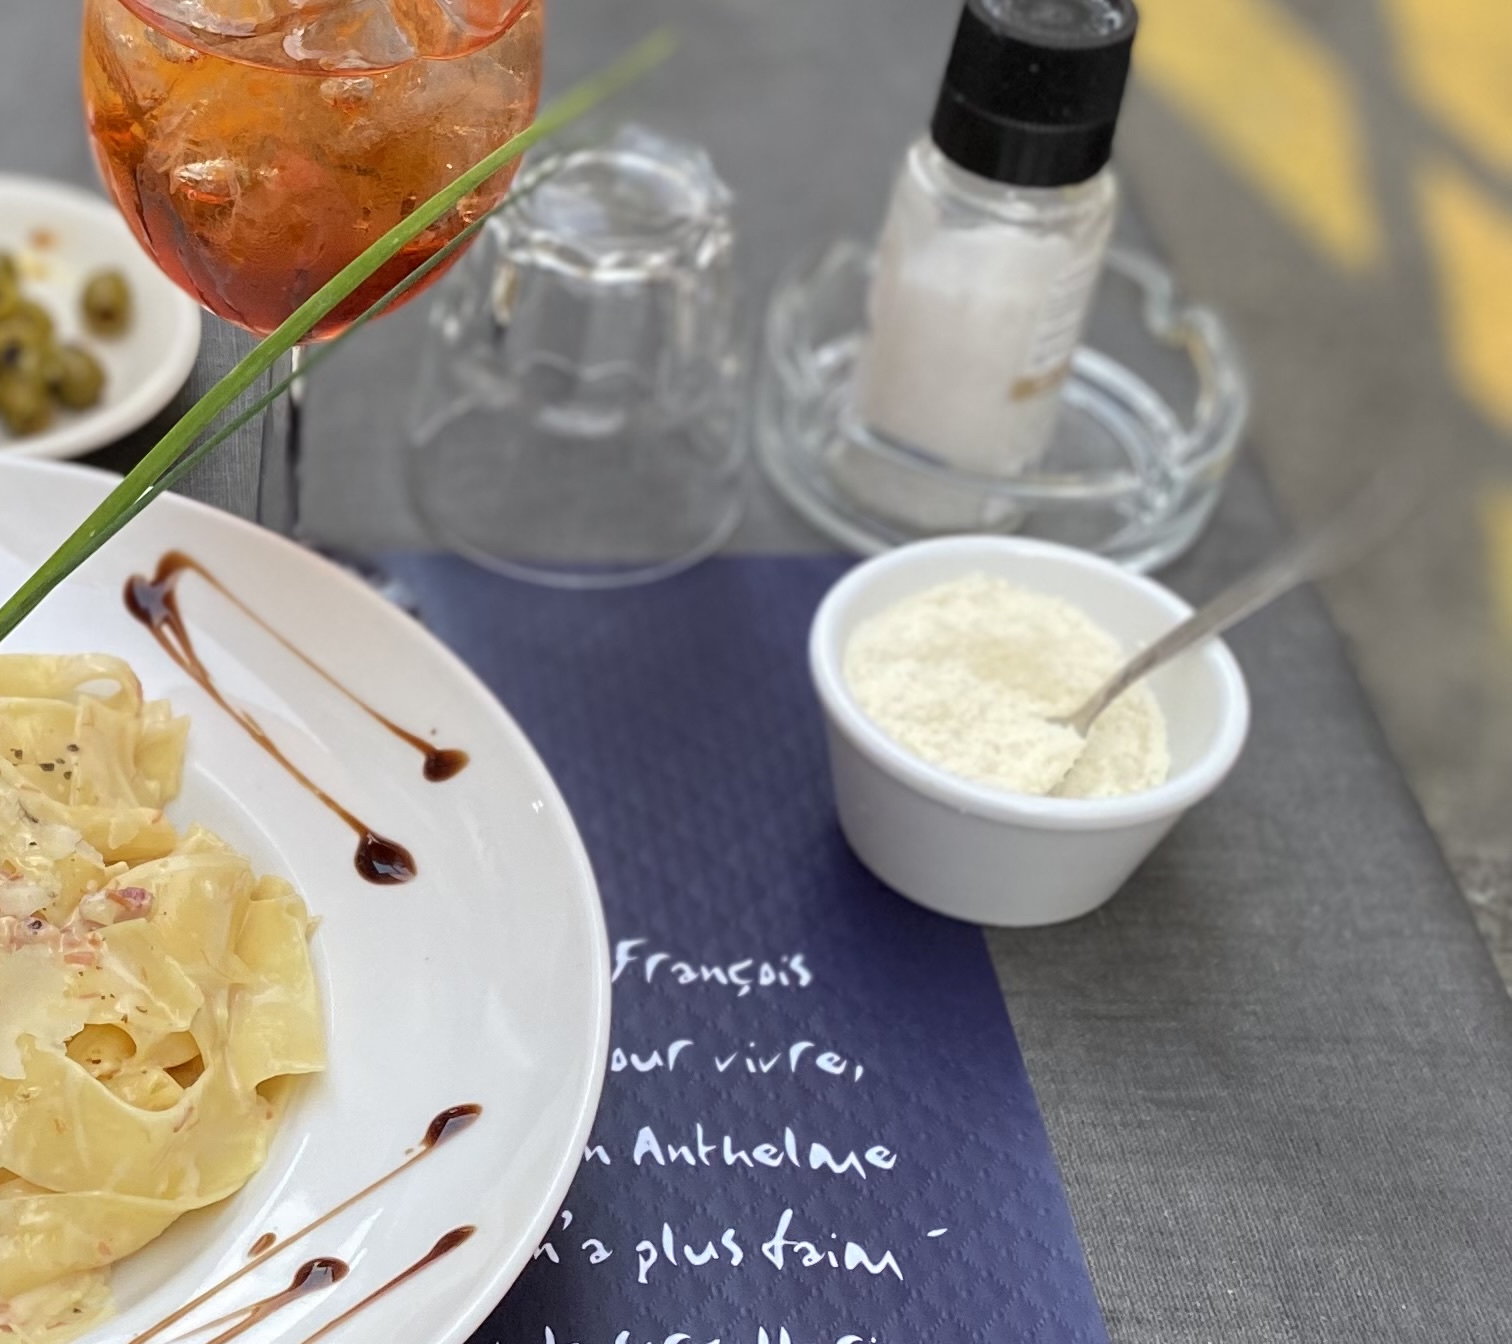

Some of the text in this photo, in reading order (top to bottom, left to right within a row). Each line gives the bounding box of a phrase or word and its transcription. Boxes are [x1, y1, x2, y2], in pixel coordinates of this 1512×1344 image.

[611, 938, 813, 997] François
[610, 1039, 864, 1083] our vivre,
[633, 1122, 897, 1180] Anthelme
[635, 1222, 745, 1284] plus
[761, 1208, 904, 1281] faim
